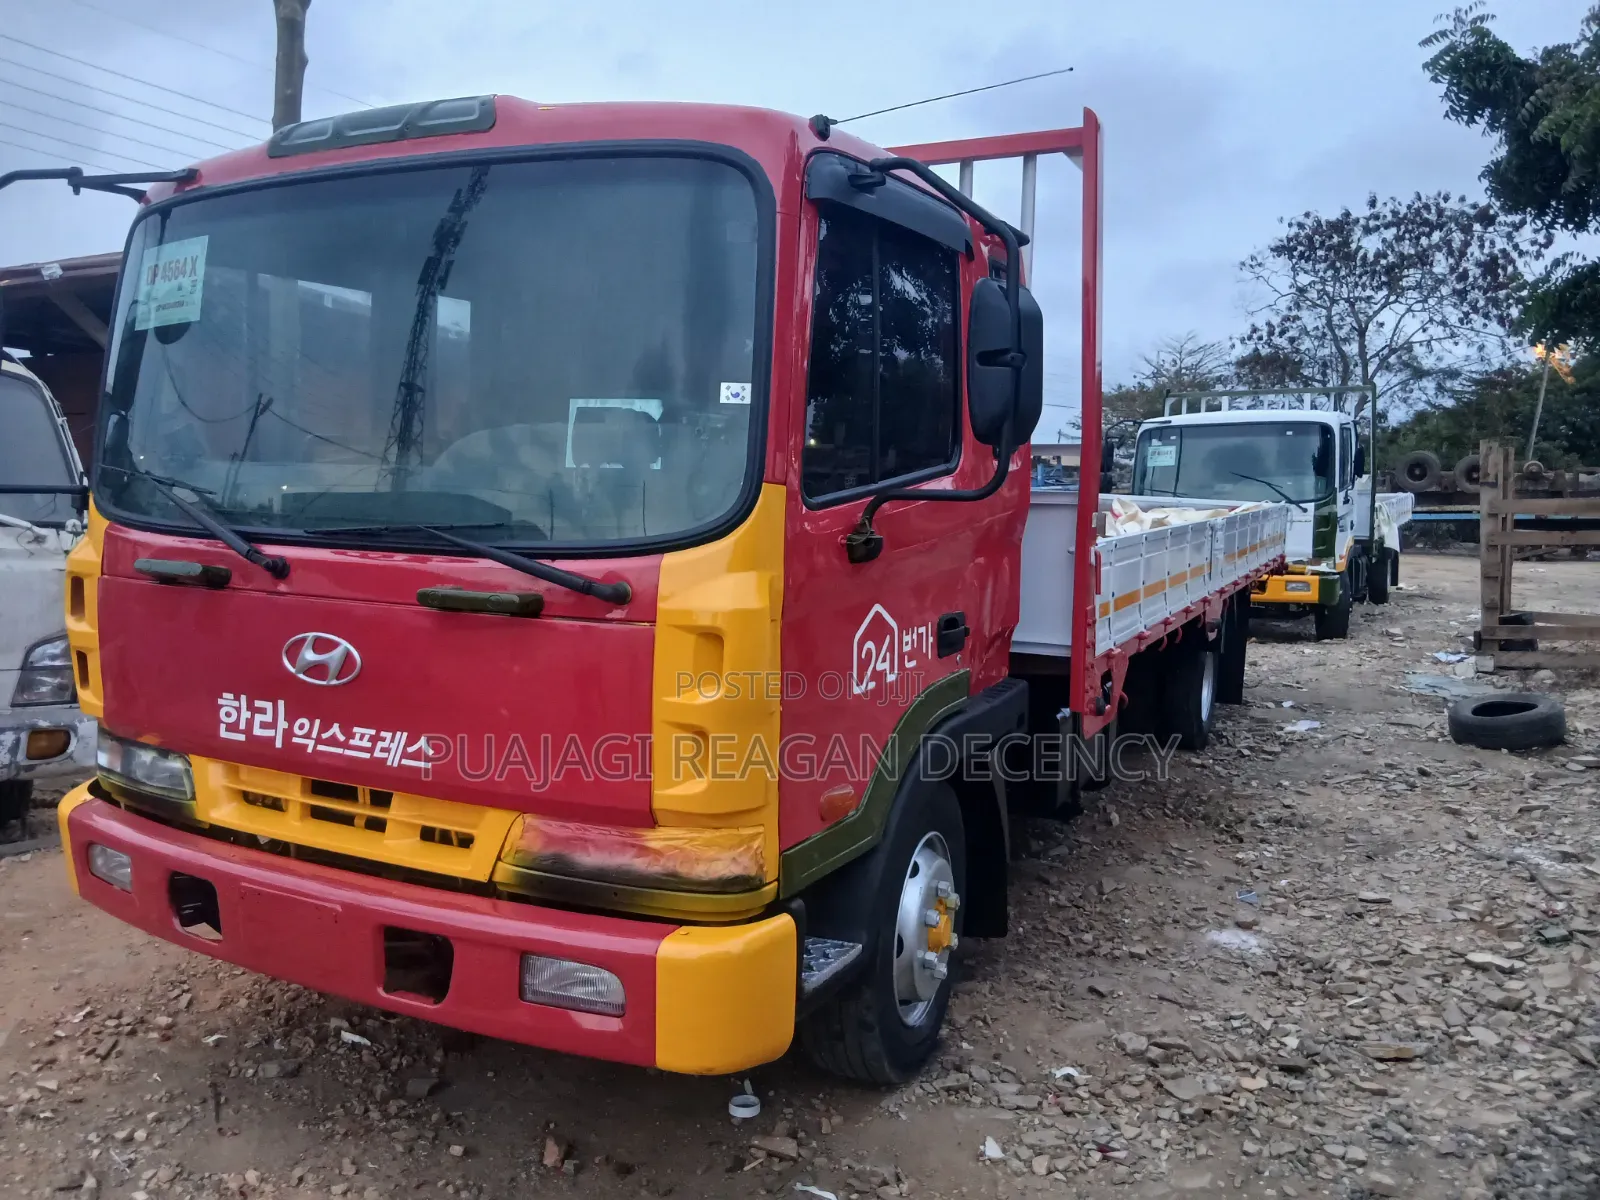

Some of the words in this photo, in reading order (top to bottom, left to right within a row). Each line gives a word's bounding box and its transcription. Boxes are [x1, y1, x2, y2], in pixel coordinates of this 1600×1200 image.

[146, 264, 159, 286] DP
[161, 256, 187, 283] 4564
[188, 255, 199, 278] X
[861, 634, 892, 692] 24
[902, 621, 934, 669] 번가
[217, 692, 289, 749] 한라
[291, 717, 435, 768] 익스프레스
